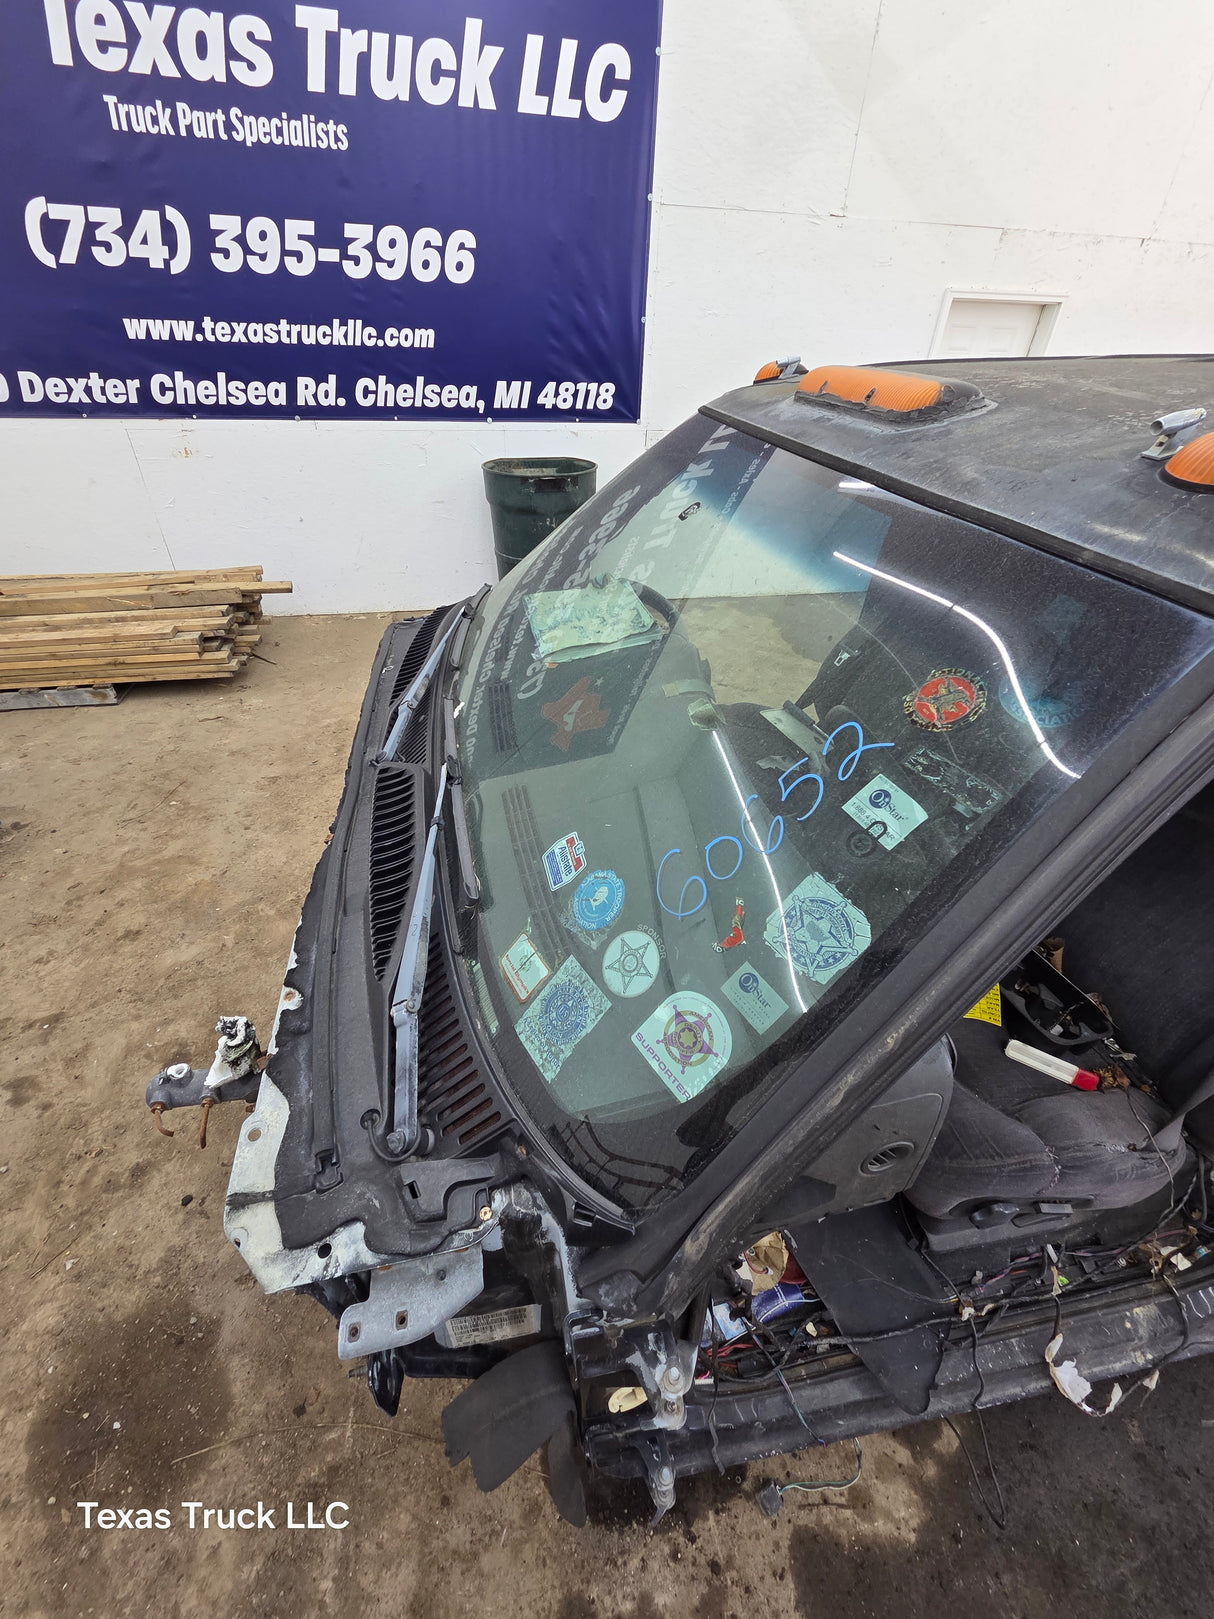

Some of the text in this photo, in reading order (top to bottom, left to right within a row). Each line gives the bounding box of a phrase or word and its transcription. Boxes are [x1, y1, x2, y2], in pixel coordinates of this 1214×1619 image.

[43, 0, 633, 123] Texas Truck LLC
[102, 94, 349, 151] Truck Part Specialists
[24, 195, 477, 284] (734) 395-3966
[122, 316, 435, 349] www.texastruckllc.com
[17, 370, 141, 405] Dexter
[150, 370, 287, 406] Chelsea
[296, 373, 346, 407] Rd.
[355, 375, 486, 413] Chelsea,
[493, 380, 532, 409] MI
[536, 381, 616, 410] 48118
[656, 721, 895, 921] 60652
[869, 788, 906, 824] OnStar
[557, 846, 573, 877] Allstate
[636, 922, 667, 960] SPONSOR
[739, 972, 774, 1010] OnStar
[687, 1010, 715, 1042] AMERICAN
[634, 1030, 692, 1102] SUPPORTER
